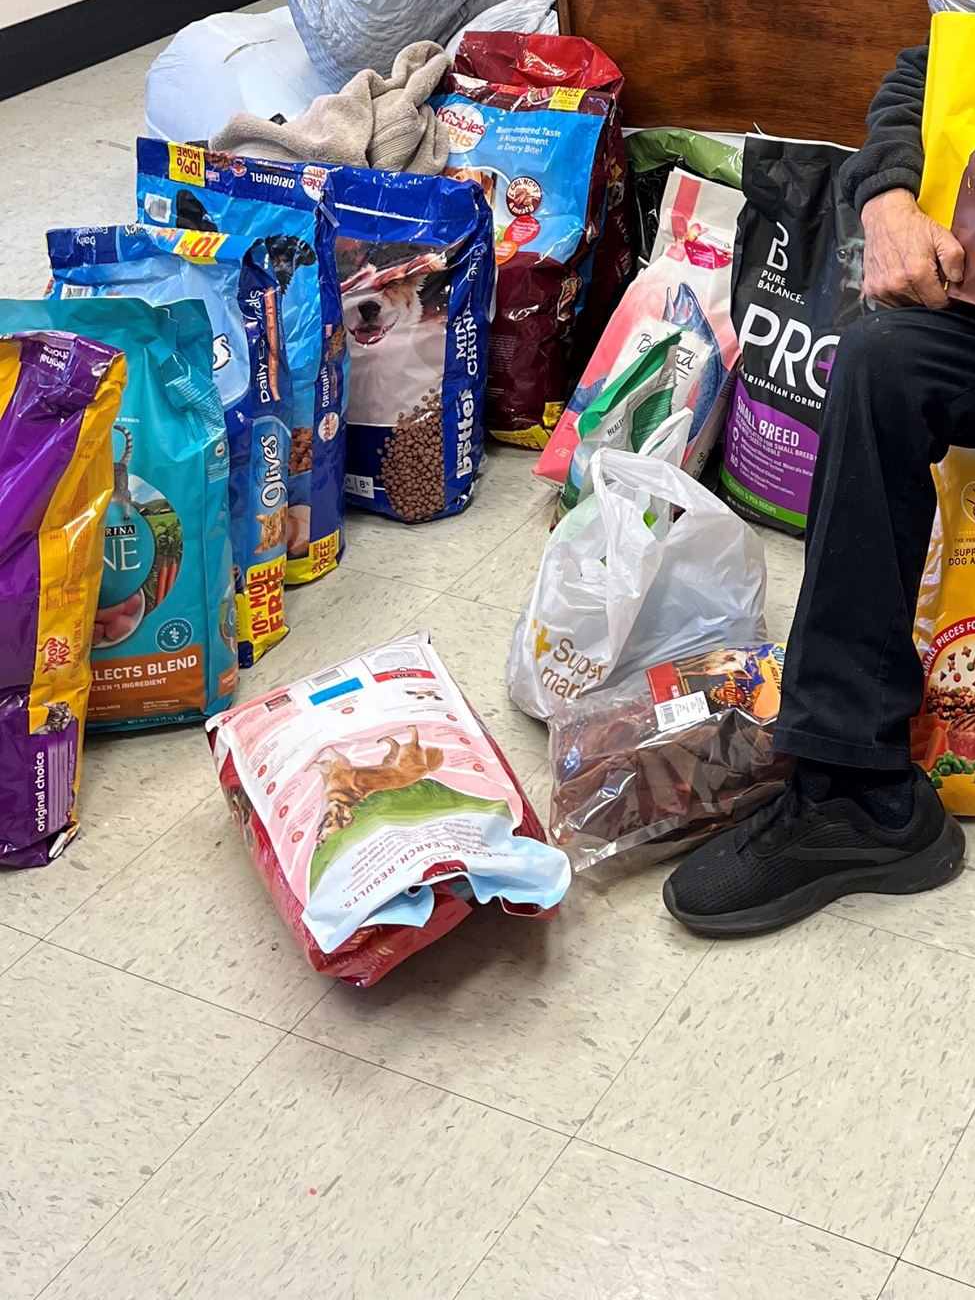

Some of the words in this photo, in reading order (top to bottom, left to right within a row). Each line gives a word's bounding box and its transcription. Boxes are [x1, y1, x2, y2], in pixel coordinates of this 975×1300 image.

[504, 135, 549, 145] Nourishment
[542, 127, 562, 138] Taste
[176, 146, 201, 160] MORE
[504, 144, 523, 154] Every
[524, 145, 543, 155] Bite!
[176, 157, 202, 178] 10%
[250, 172, 296, 189] ORIGINAL
[76, 234, 97, 246] Daily
[180, 237, 219, 258] 10%
[760, 269, 786, 287] PURE
[757, 279, 802, 304] BALANCE
[256, 362, 271, 404] Daily
[737, 395, 757, 431] SMALL
[759, 419, 800, 447] BREED
[774, 441, 794, 455] SMALL
[795, 449, 814, 461] BREED
[105, 525, 135, 537] RINA
[319, 541, 330, 573] FREE
[948, 557, 967, 566] DOG
[267, 564, 284, 634] FREE
[251, 611, 269, 640] 10%
[552, 637, 608, 681] Super
[923, 646, 938, 677] SMALL
[936, 623, 965, 648] PIECES
[146, 654, 198, 675] BLEND
[121, 677, 167, 689] INGREDIENT
[35, 751, 45, 792] choice
[37, 792, 48, 833] original
